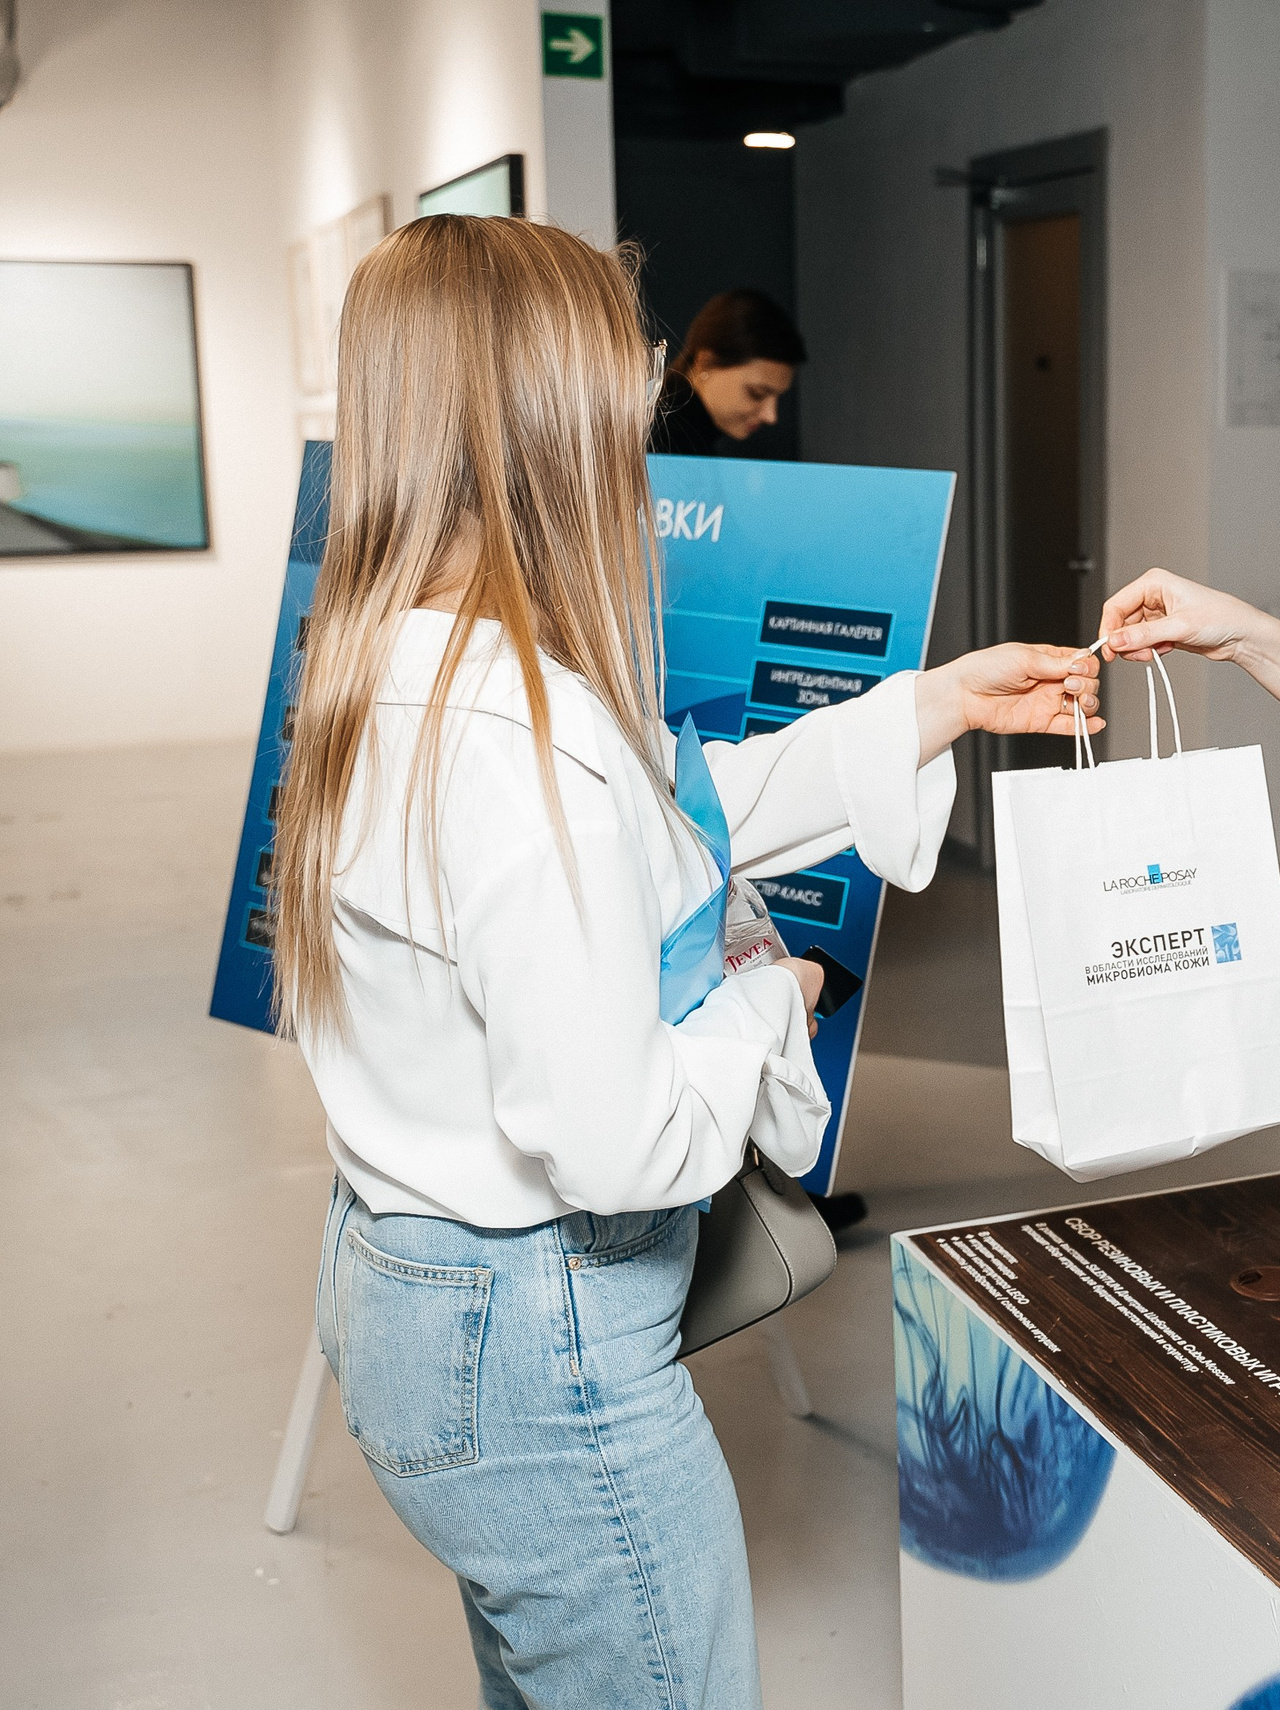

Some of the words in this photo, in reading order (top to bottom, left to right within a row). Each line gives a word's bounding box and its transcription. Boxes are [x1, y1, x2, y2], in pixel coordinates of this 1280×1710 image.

[637, 498, 724, 543] ВКИ
[833, 622, 883, 641] ГАЛЕРЕЯ
[1103, 880, 1119, 892] LA
[1119, 873, 1160, 889] ROCHE
[1160, 868, 1197, 883] POSAY
[1111, 928, 1205, 959] ЭКСПЕРТ
[1085, 966, 1091, 975] В
[1092, 959, 1134, 973] ОБЛАСТИ
[1136, 946, 1209, 966] ИССЛЕДОВАНИЙ
[1086, 963, 1172, 986] МИКРОБИОМА
[1174, 956, 1210, 972] КОЖИ
[1006, 1288, 1029, 1304] LEGO
[1065, 1218, 1102, 1239] СБОР
[1092, 1240, 1166, 1291] РЕЗИНОВЫХ
[1155, 1290, 1175, 1299] И
[1165, 1298, 1265, 1371] ПЛАСТИКОВЫХ
[1163, 1343, 1199, 1373] скульптур
[1183, 1345, 1235, 1384] Cube.Moscow
